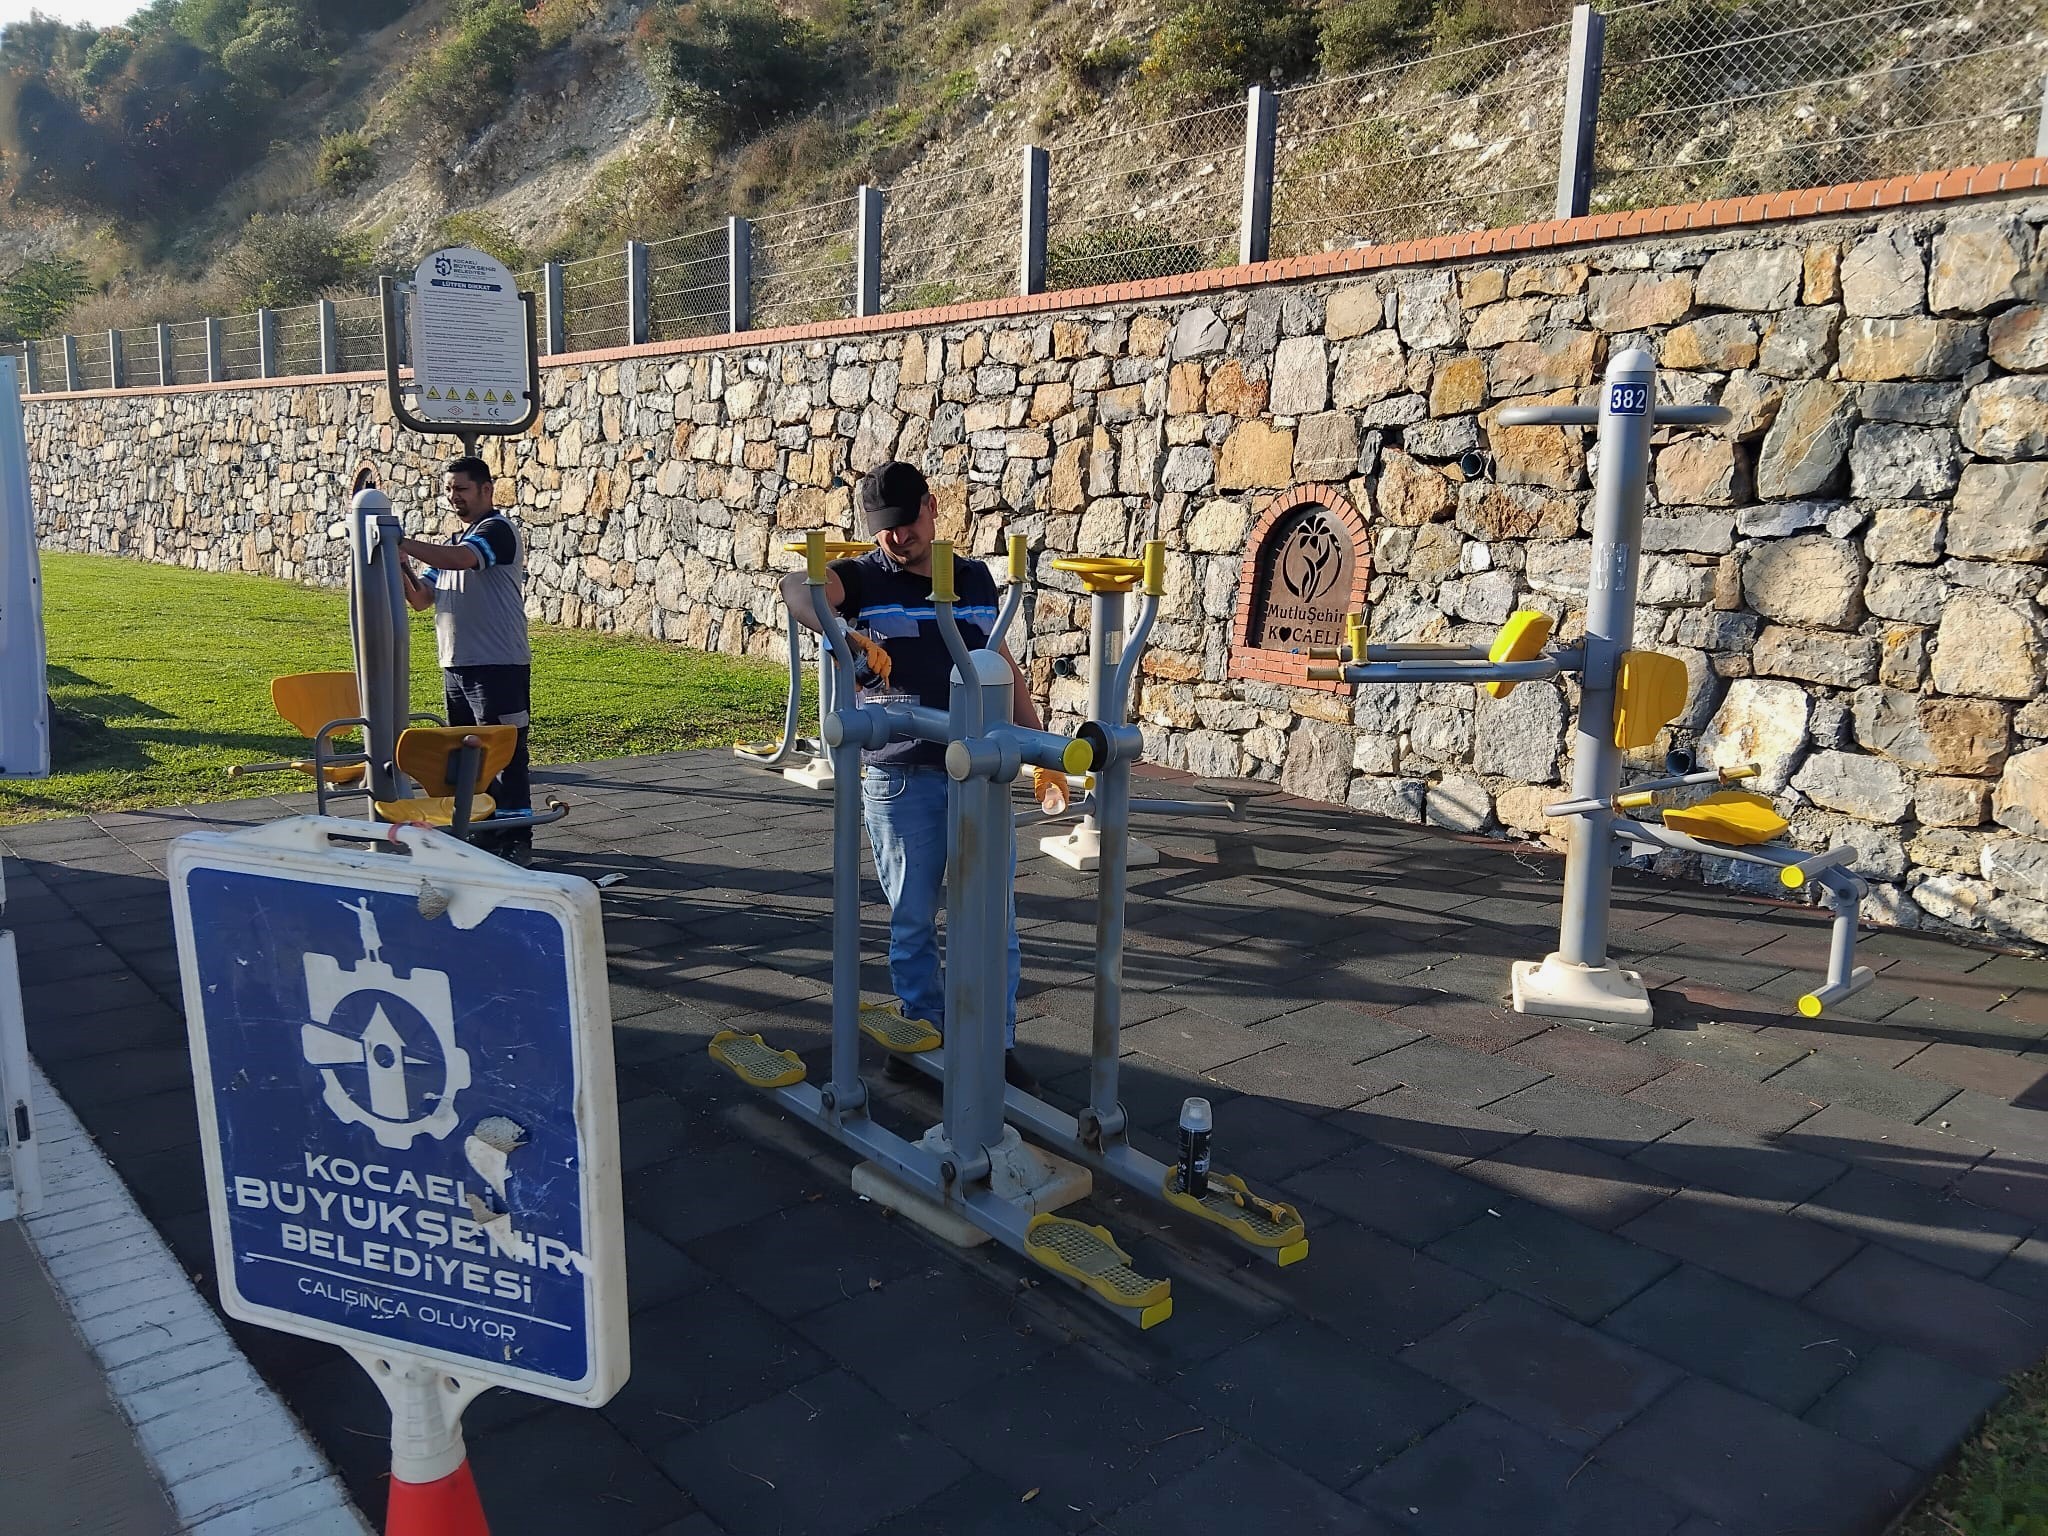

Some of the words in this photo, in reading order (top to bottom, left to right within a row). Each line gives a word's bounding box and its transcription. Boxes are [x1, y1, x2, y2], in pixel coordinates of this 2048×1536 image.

[1613, 389, 1644, 408] 382
[1267, 604, 1345, 624] MutluŞehir
[281, 1222, 532, 1303] BELEDİYESİ
[418, 1307, 516, 1341] OLUYOR
